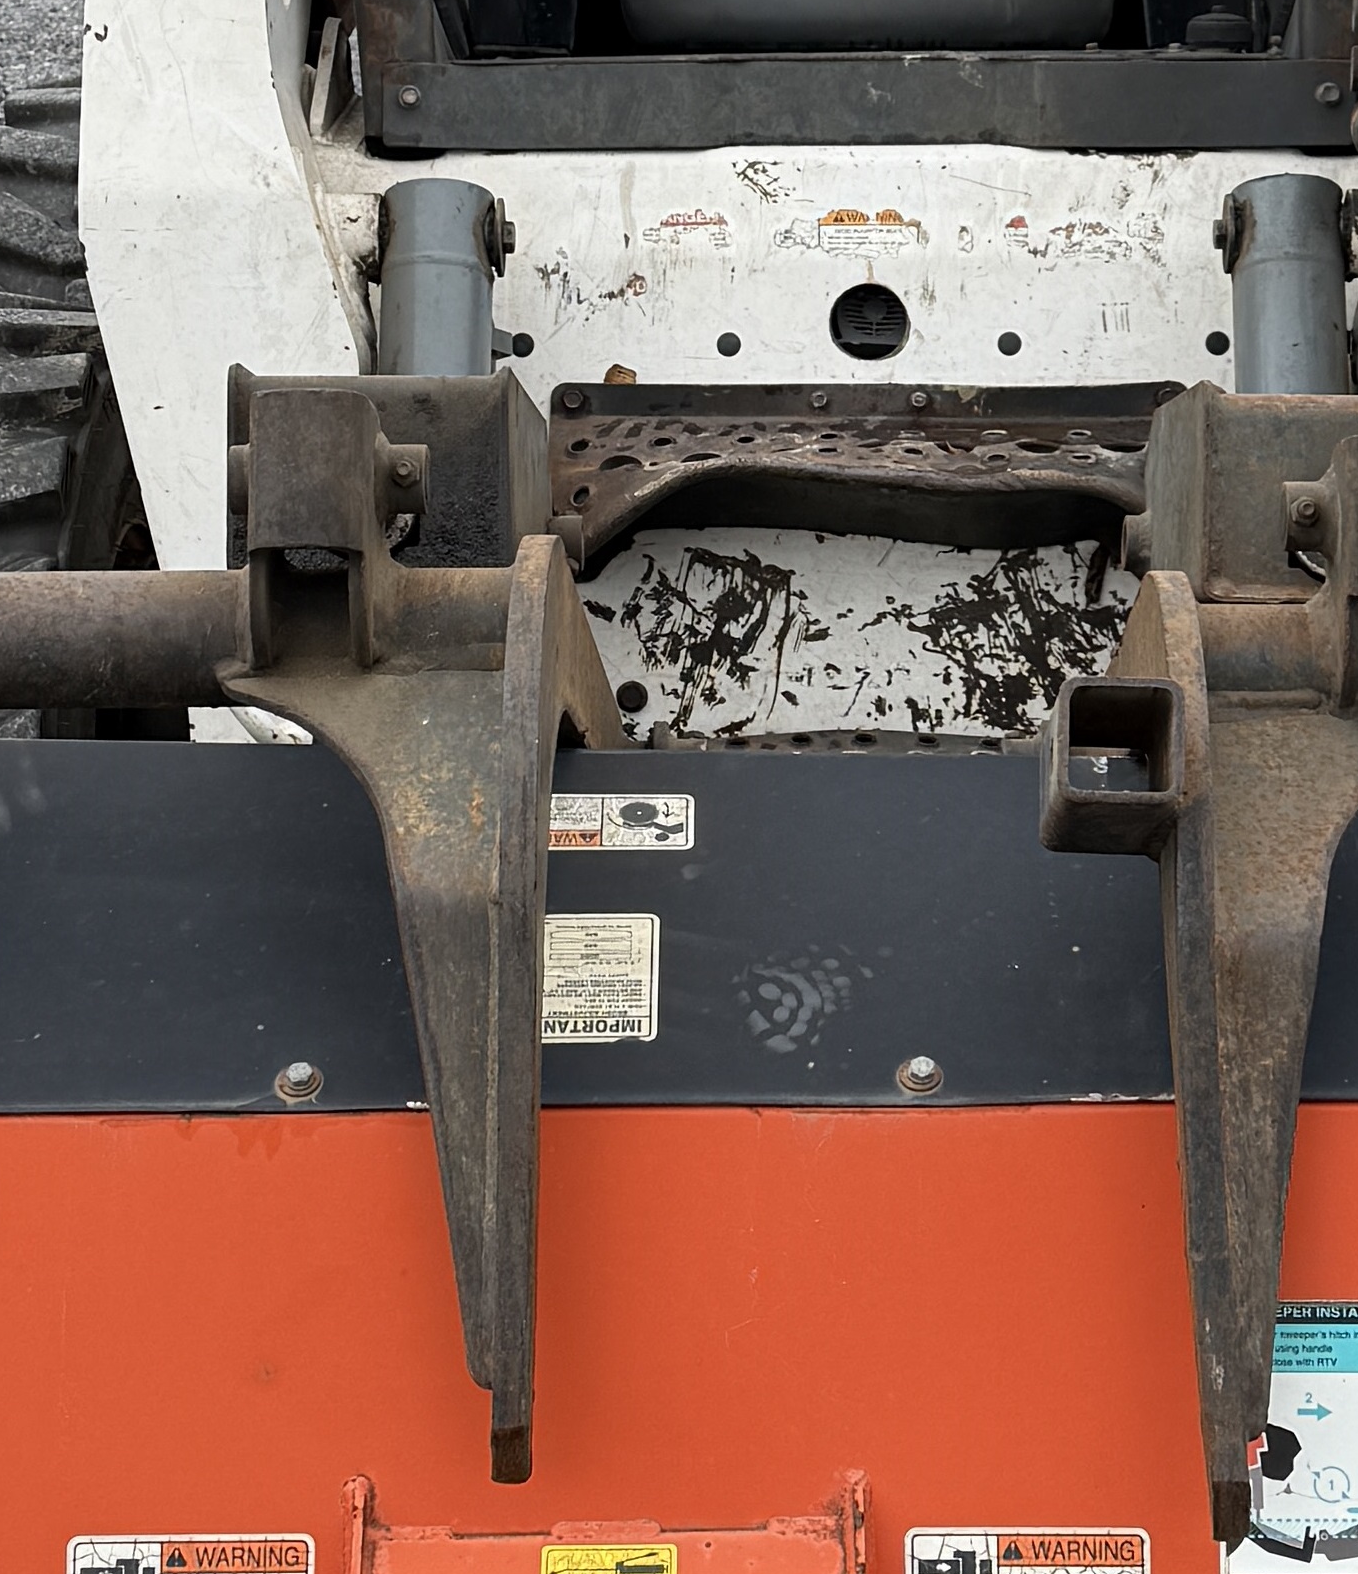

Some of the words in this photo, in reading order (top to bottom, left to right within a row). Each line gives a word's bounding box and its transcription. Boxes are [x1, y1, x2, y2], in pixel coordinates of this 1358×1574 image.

[543, 1019, 642, 1033] IMPORTAN
[1329, 1330, 1351, 1340] hitch
[1301, 1344, 1333, 1353] handle
[1317, 1357, 1338, 1367] RTV
[1305, 1392, 1313, 1403] 2
[1329, 1480, 1335, 1490] 1
[1032, 1540, 1135, 1561] WARNING
[196, 1547, 300, 1567] WARNING
